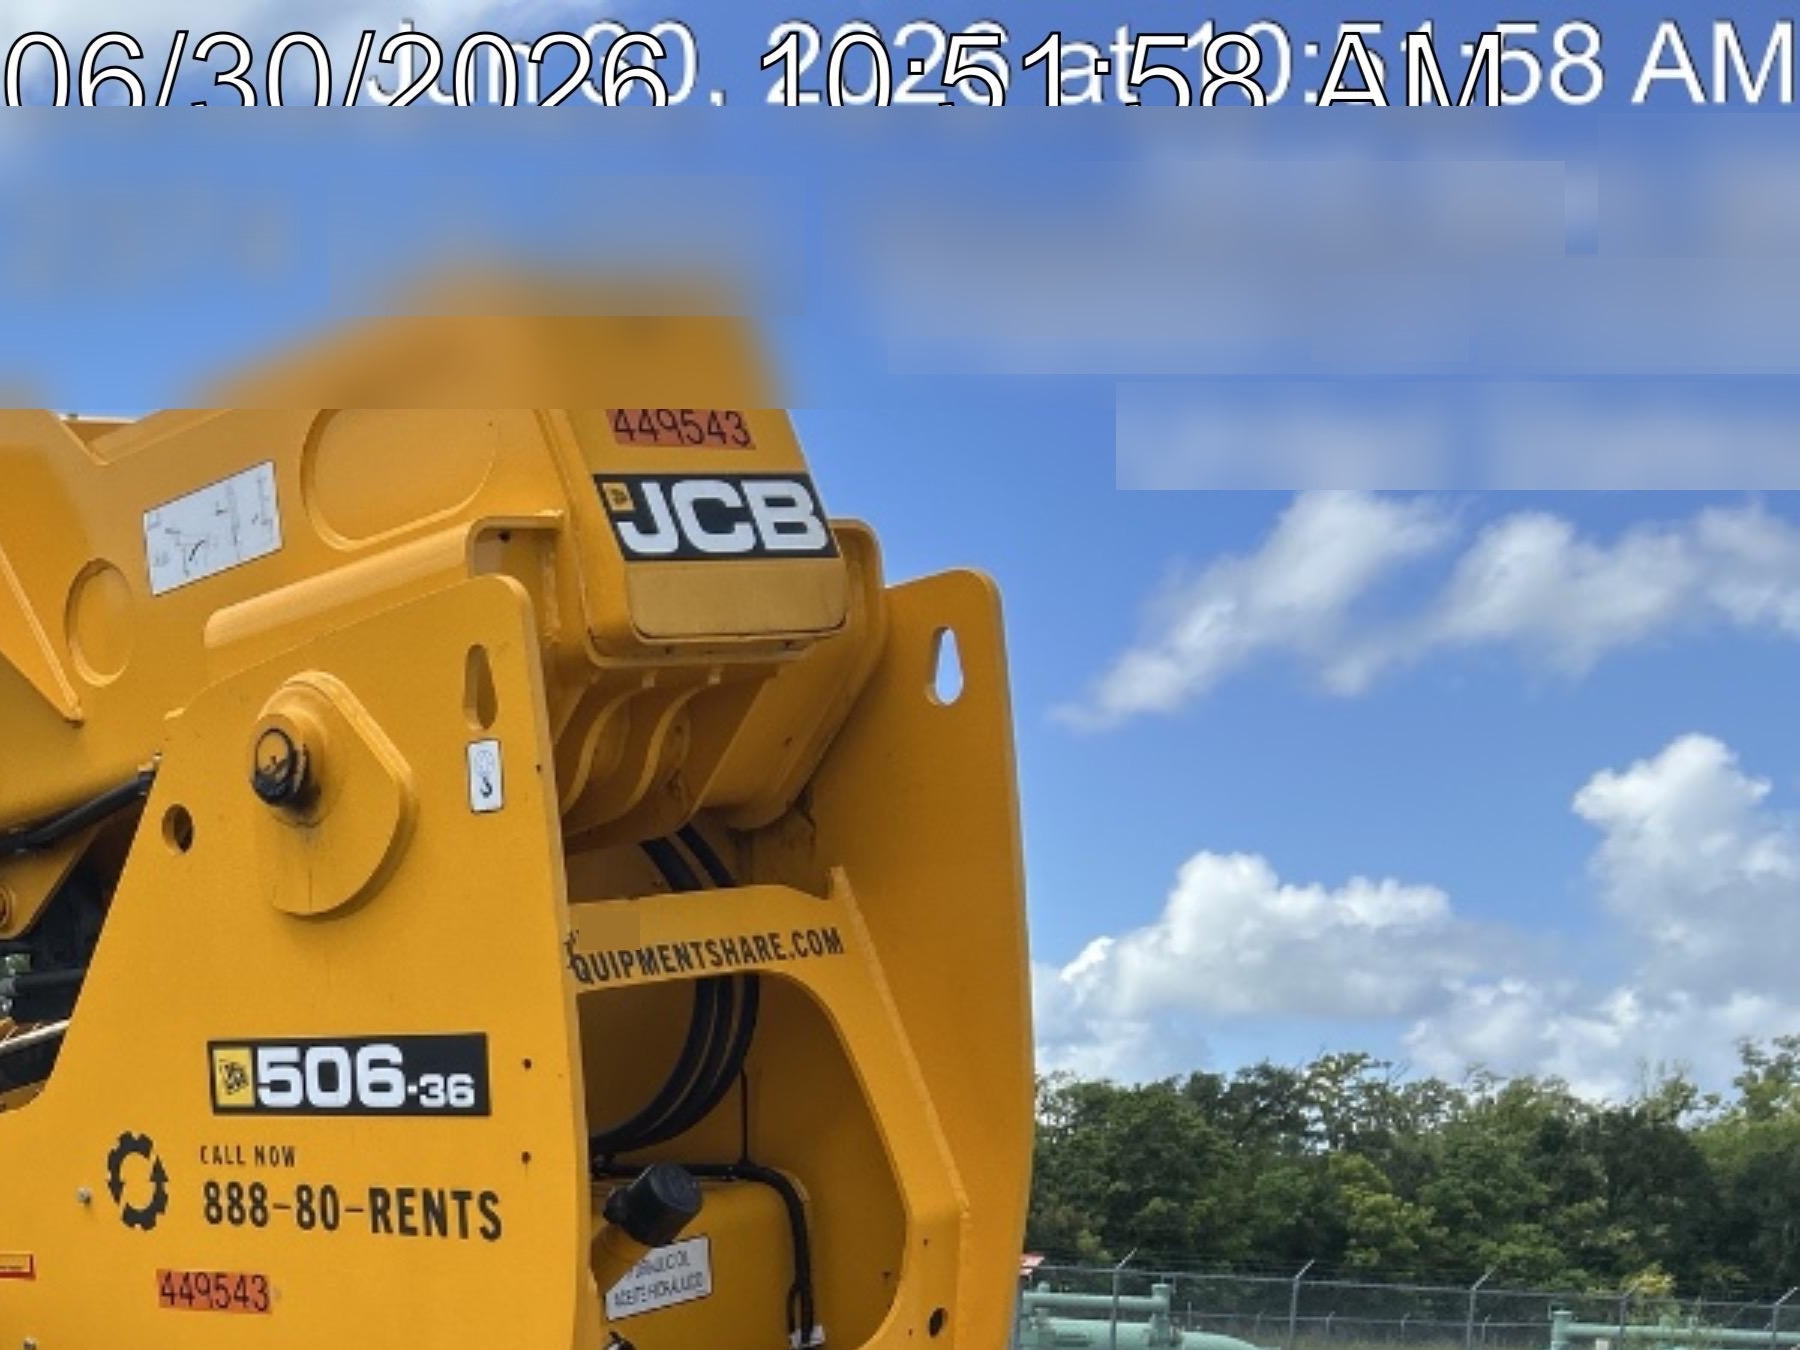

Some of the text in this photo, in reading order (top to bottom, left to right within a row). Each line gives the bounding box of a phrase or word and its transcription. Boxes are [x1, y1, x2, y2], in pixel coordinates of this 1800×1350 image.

[613, 409, 751, 447] 449543
[616, 480, 828, 553] JCB
[568, 926, 844, 984] QUIPMENTSHARE.COM
[200, 1145, 296, 1168] CALL NOW
[203, 1180, 503, 1241] 888-80-RENTS
[161, 1271, 269, 1313] 449543
